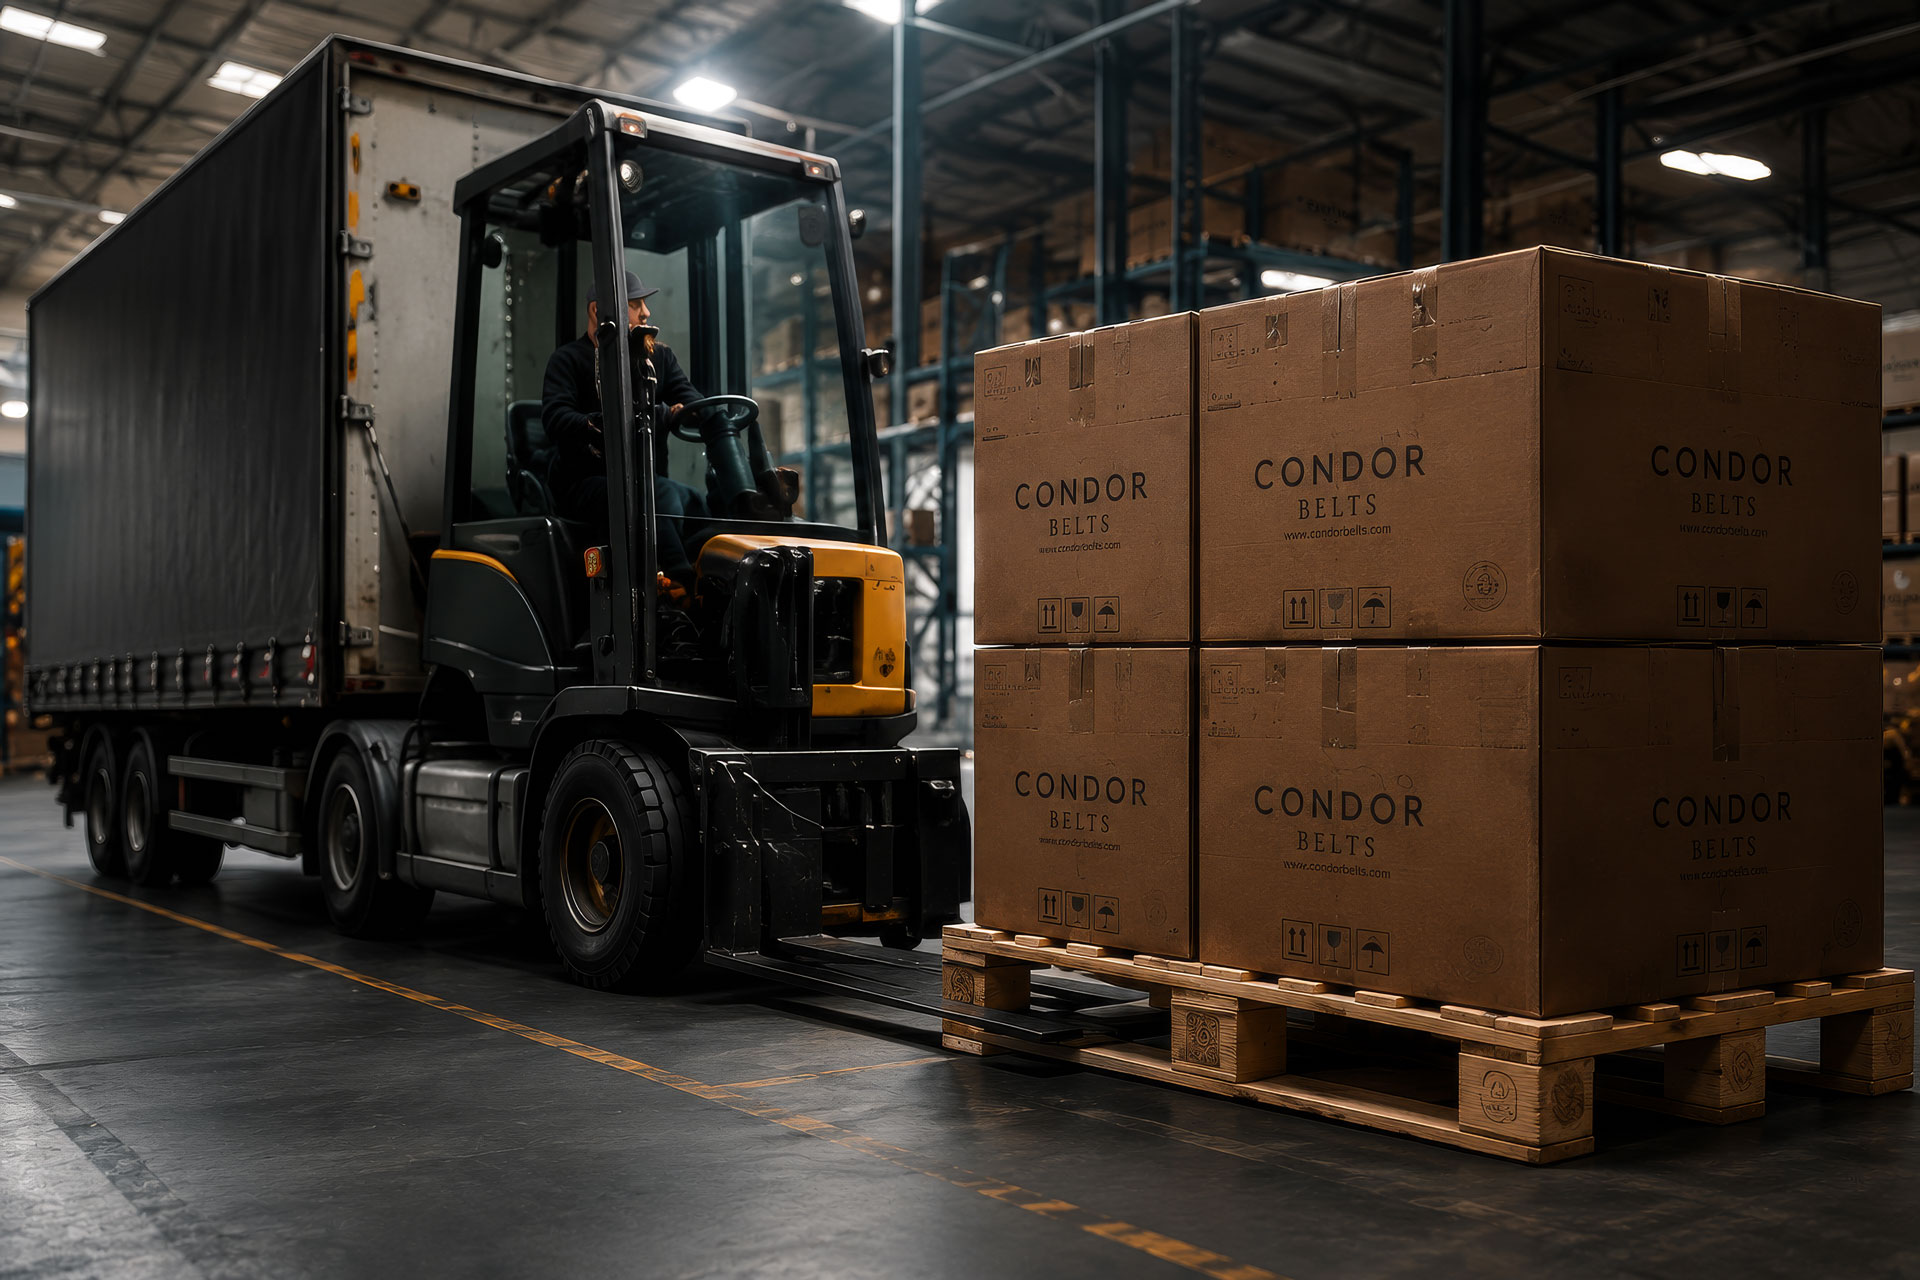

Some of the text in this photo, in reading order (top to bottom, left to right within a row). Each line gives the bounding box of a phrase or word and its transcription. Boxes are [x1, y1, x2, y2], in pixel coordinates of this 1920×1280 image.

[1254, 445, 1426, 490] CONDOR
[1652, 445, 1793, 486] CONDOR
[1016, 471, 1148, 510] CONDOR
[1298, 493, 1376, 520] BELTS
[1691, 493, 1757, 517] BELTS
[1049, 513, 1110, 537] BELTS
[1015, 771, 1148, 807] CONDOR
[1049, 810, 1110, 834] BELTS
[1254, 785, 1425, 827] CONDOR
[1652, 791, 1792, 829] CONDOR
[1297, 830, 1376, 858] BELTS
[1692, 836, 1756, 861] BELTS
